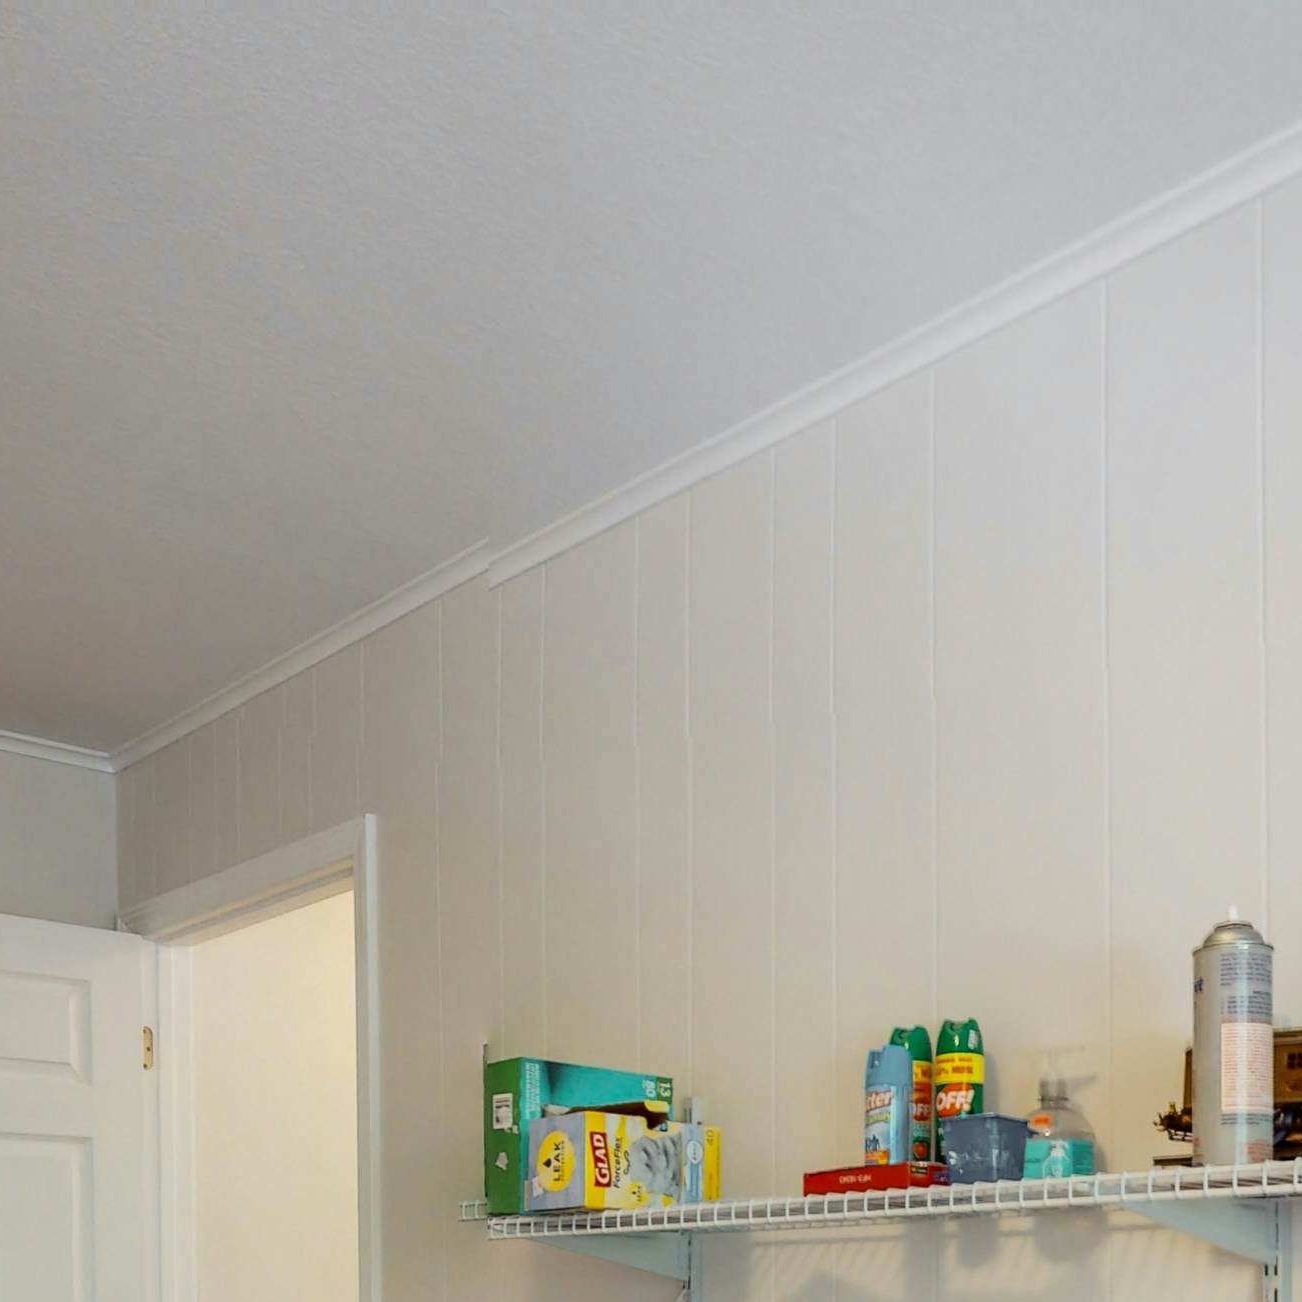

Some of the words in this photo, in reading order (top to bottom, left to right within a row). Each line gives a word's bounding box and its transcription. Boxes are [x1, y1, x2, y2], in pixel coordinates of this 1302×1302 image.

[936, 1089, 975, 1111] OFF!
[553, 1141, 562, 1182] LEAK
[594, 1133, 610, 1184] GLAD
[612, 1137, 624, 1189] ForceFlex
